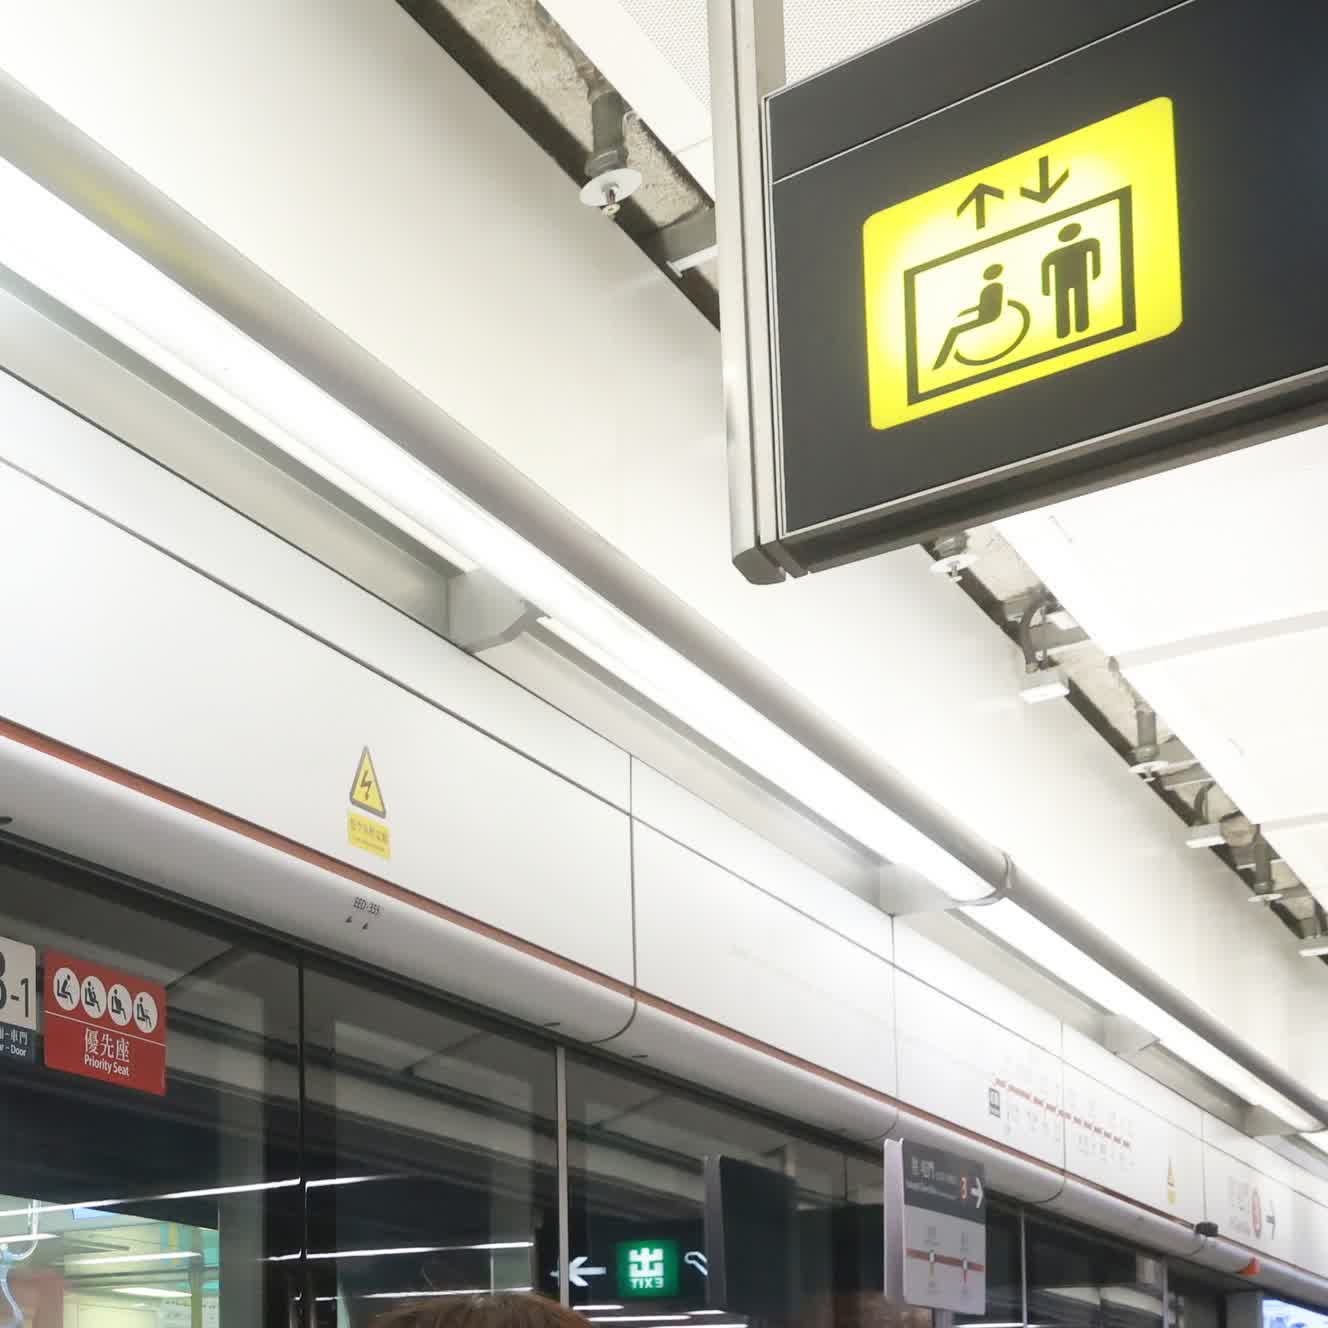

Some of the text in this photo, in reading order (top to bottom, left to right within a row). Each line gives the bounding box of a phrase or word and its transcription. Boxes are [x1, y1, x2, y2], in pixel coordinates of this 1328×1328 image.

[10, 1044, 27, 1057] Door
[84, 1027, 130, 1063] 優先座
[84, 1054, 129, 1077] Priority Seat
